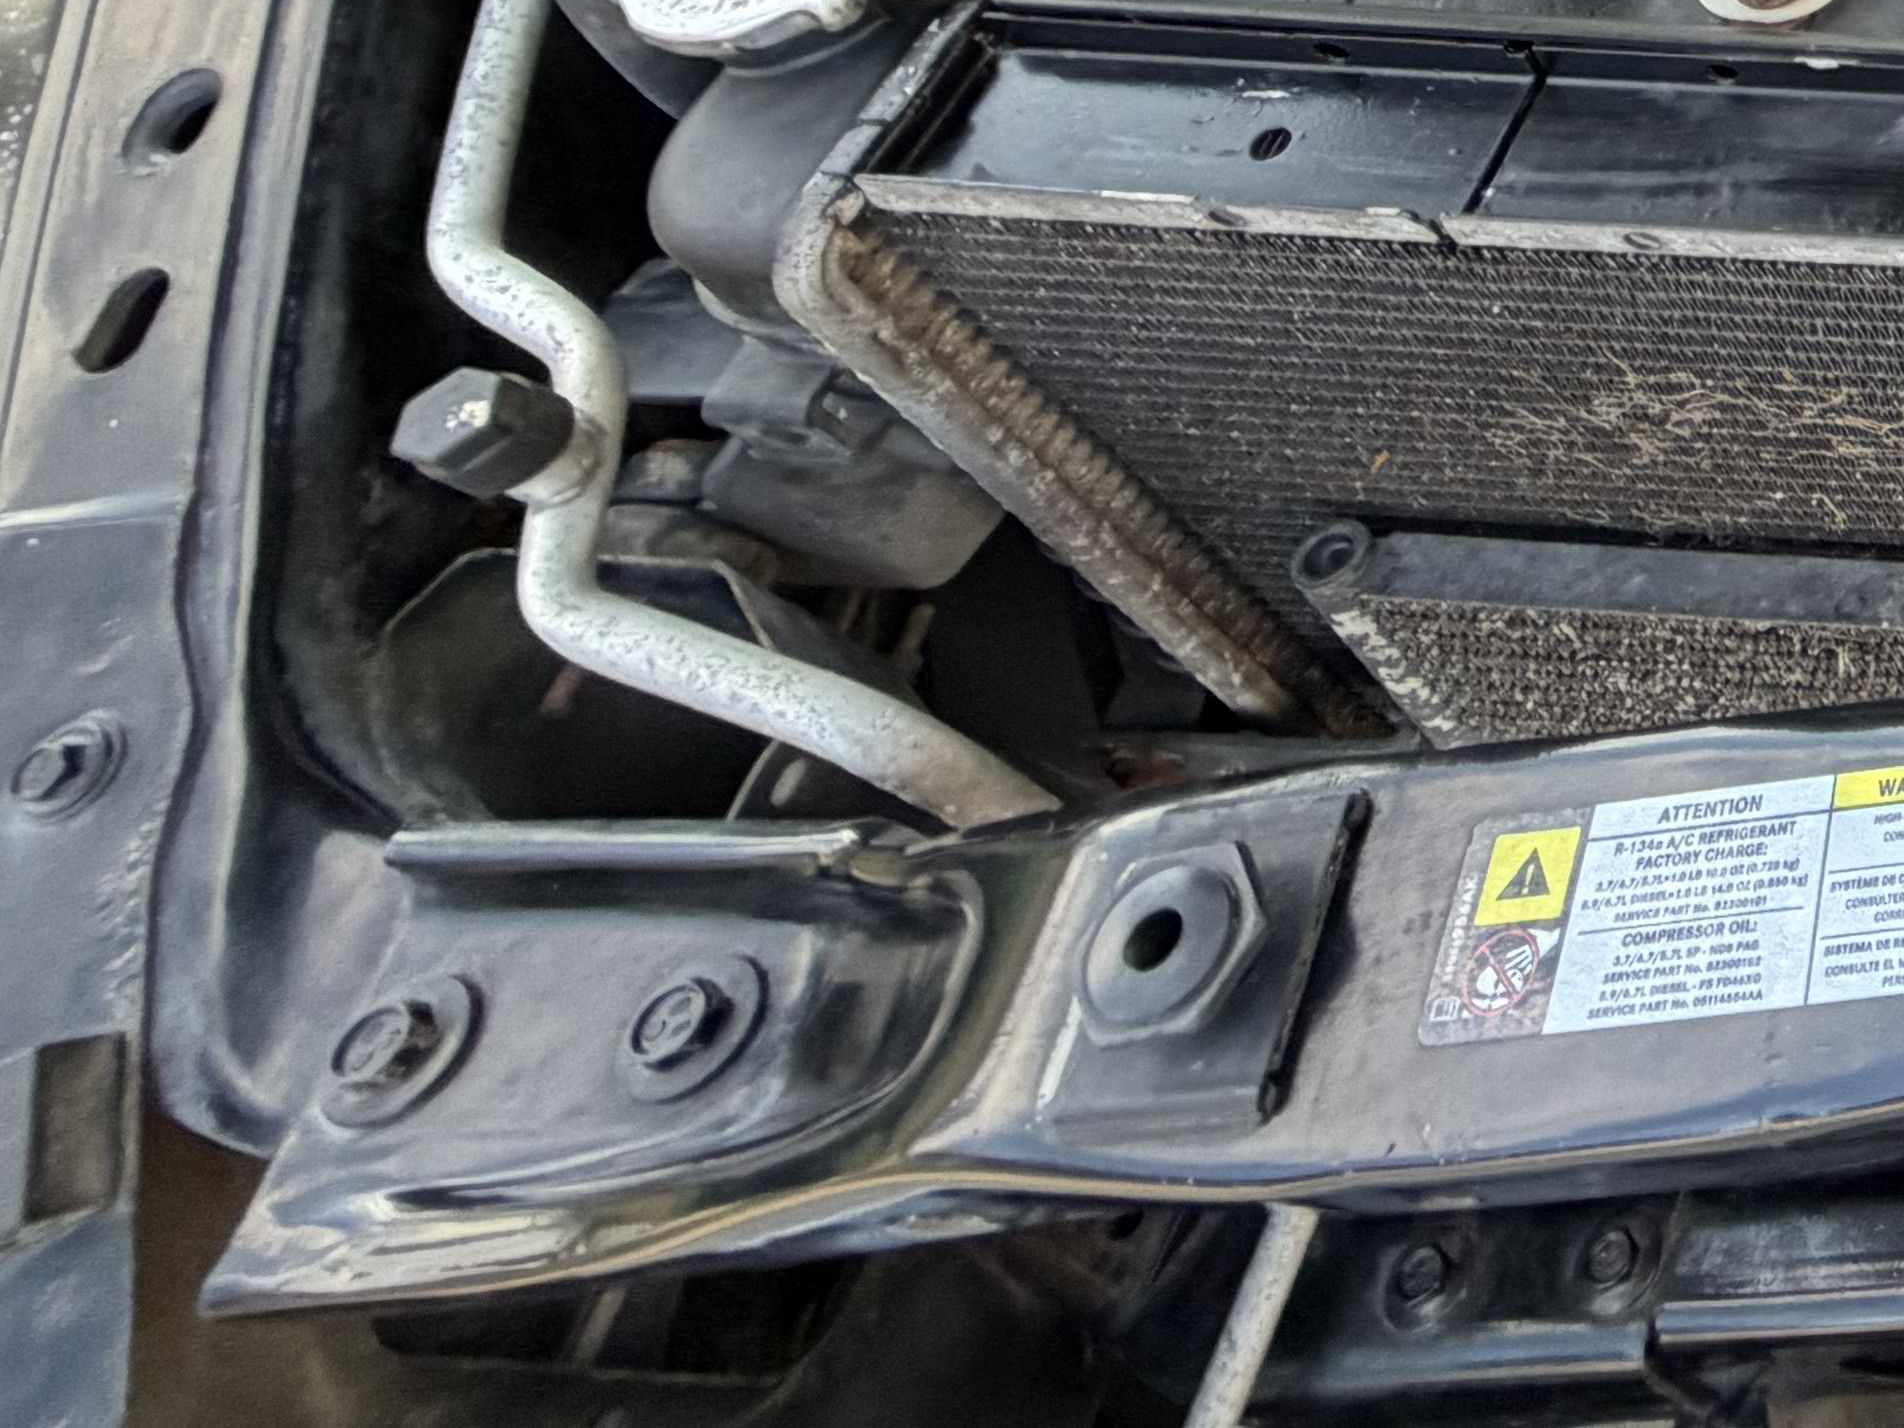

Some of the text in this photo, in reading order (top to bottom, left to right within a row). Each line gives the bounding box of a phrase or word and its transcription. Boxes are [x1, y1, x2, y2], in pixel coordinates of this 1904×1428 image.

[1657, 794, 1764, 824] ATTENTION
[1612, 820, 1797, 858] R-134a A/C REFRIGERANT
[1634, 840, 1772, 872] FACTORY CHARGE:
[1620, 917, 1762, 948] COMPRESSOR OIL:
